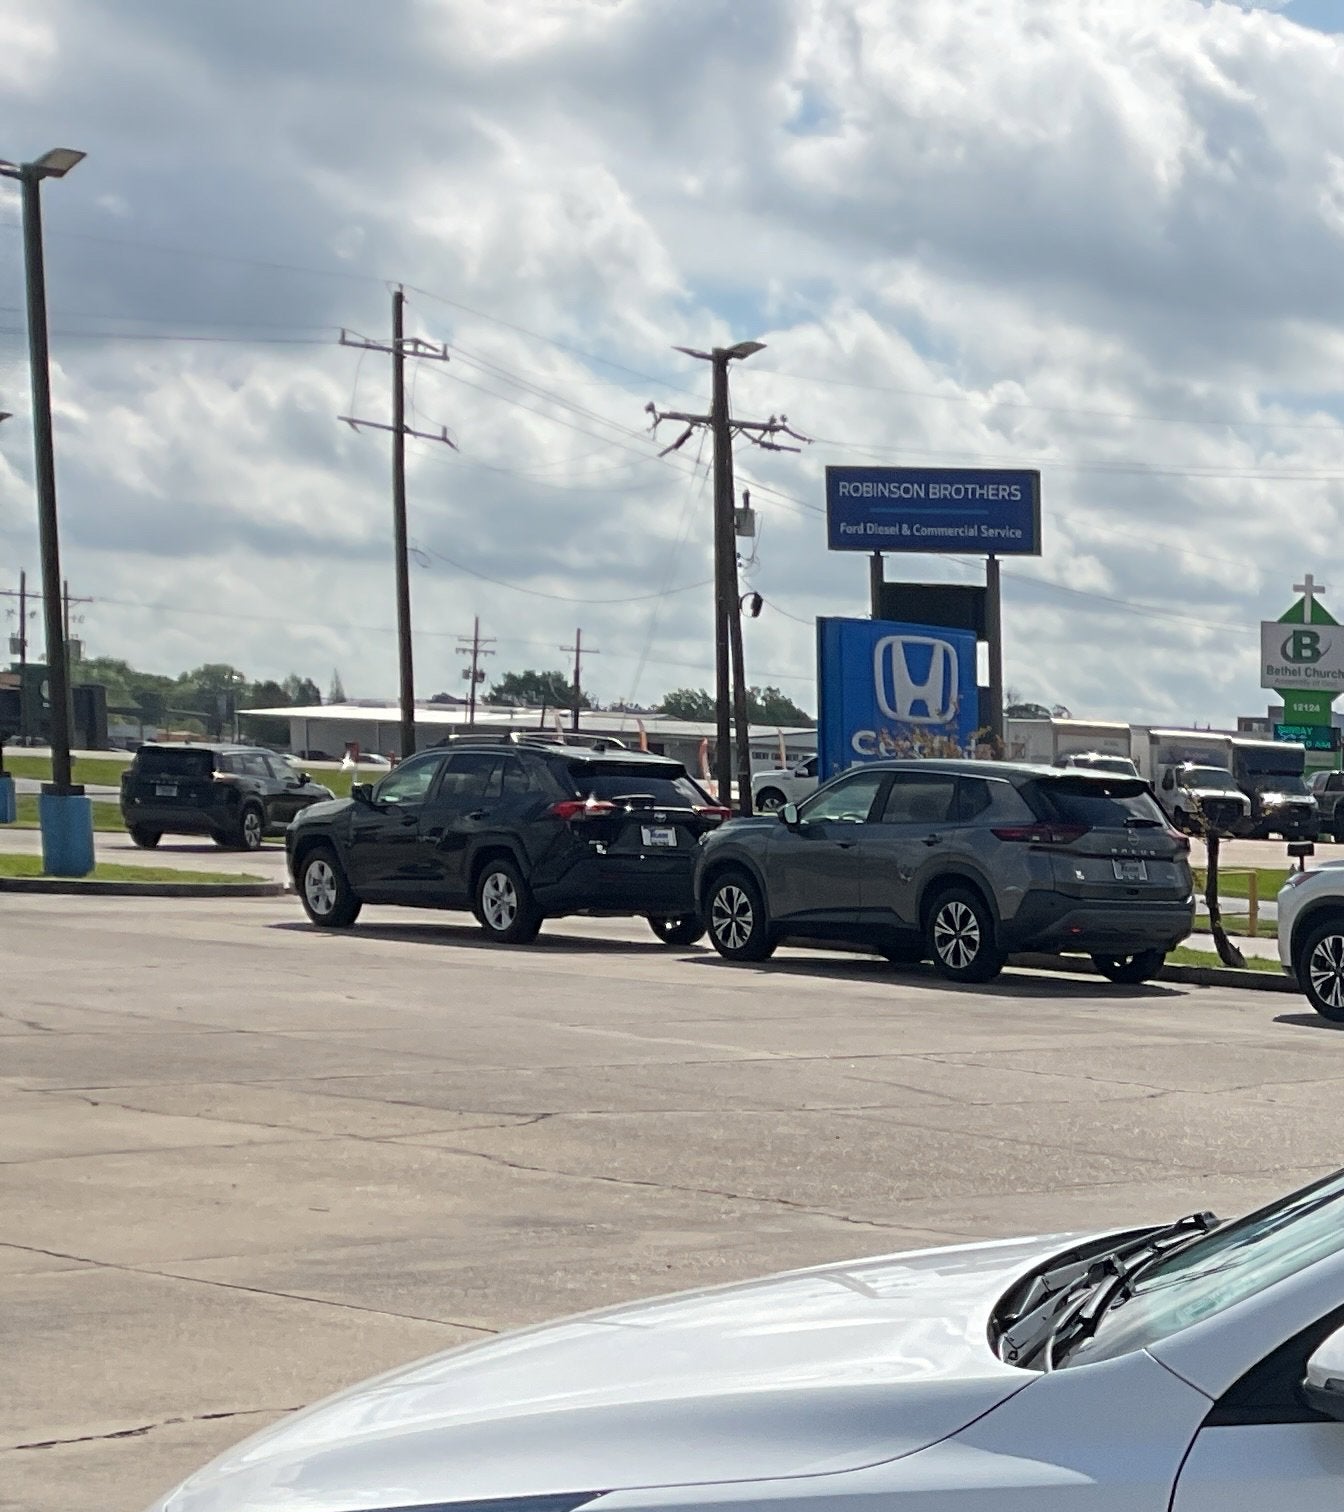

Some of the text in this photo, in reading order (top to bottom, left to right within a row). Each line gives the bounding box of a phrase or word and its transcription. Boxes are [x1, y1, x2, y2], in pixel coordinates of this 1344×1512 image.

[838, 481, 1022, 501] ROBINSON BROTHERS
[839, 522, 1023, 539] Ford Diesel & Commercial Service
[1266, 664, 1344, 679] Bethel Church
[1293, 703, 1320, 712] 12124
